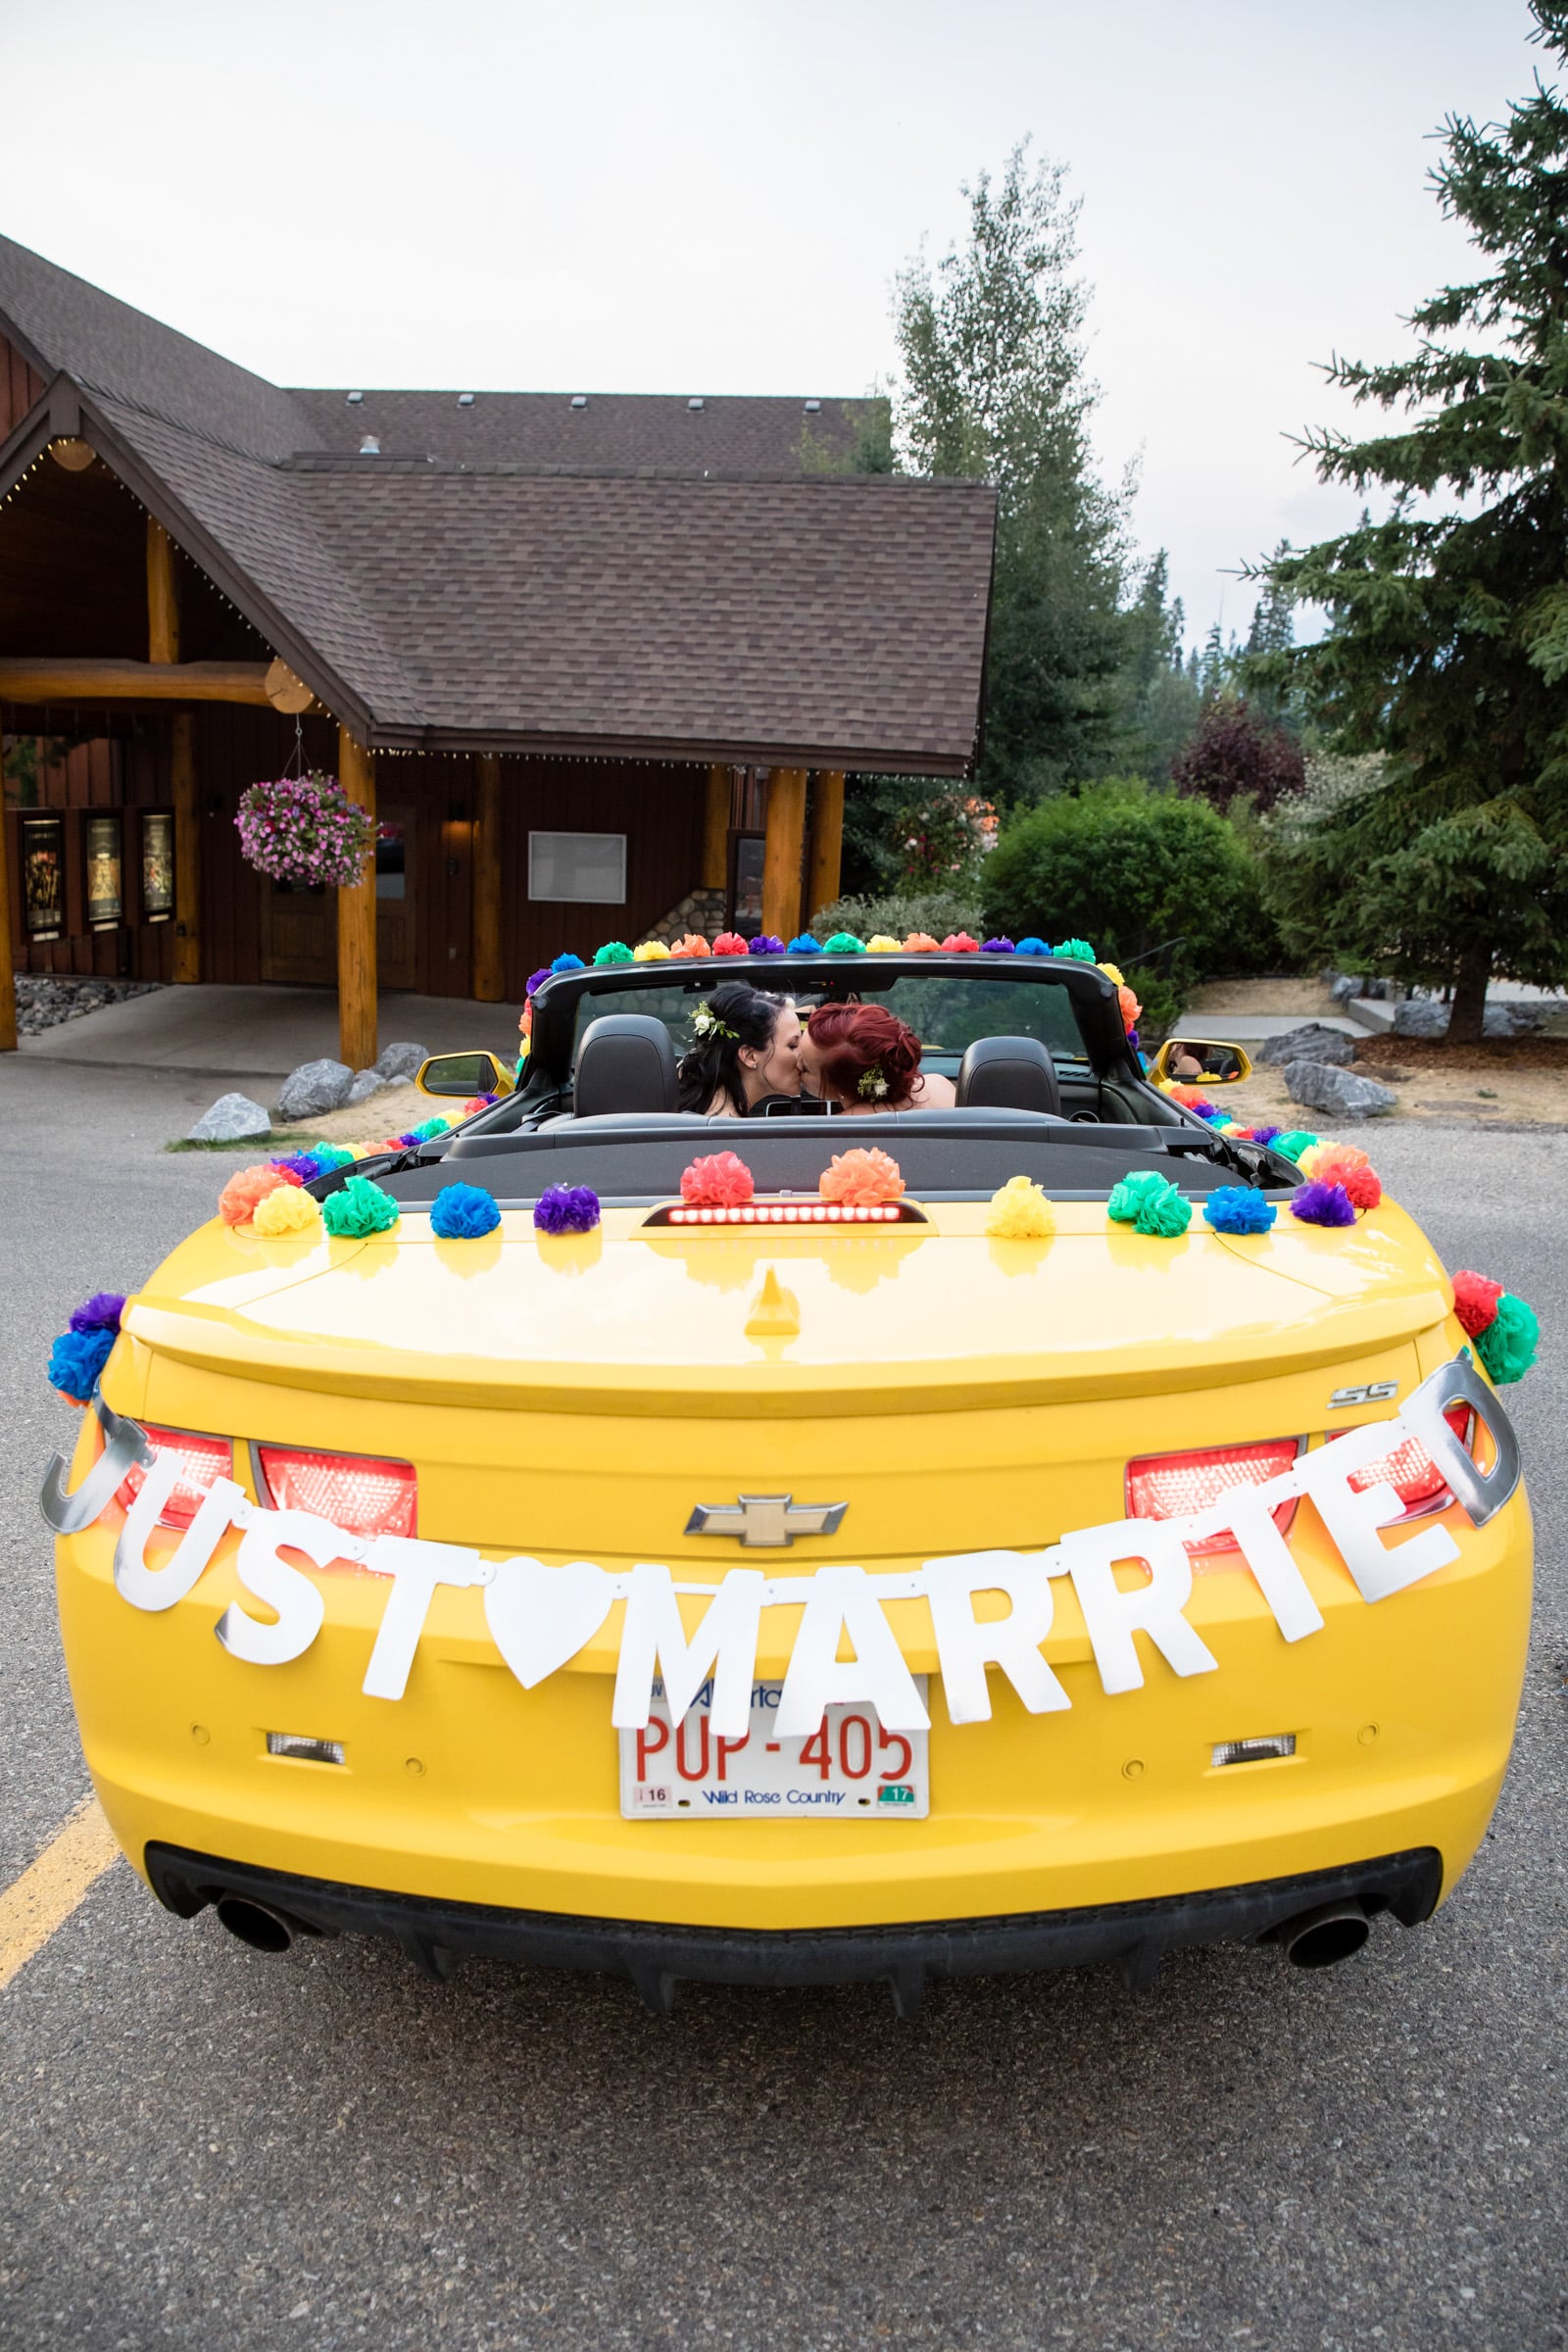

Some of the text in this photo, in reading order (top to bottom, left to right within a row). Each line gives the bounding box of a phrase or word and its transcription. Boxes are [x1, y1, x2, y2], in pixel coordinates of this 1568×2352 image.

[1326, 1380, 1399, 1409] SS
[39, 1346, 1521, 1739] JUST MARRIED
[648, 1788, 666, 1801] 16
[702, 1789, 846, 1805] Wild Rose Country
[892, 1788, 908, 1800] 17
